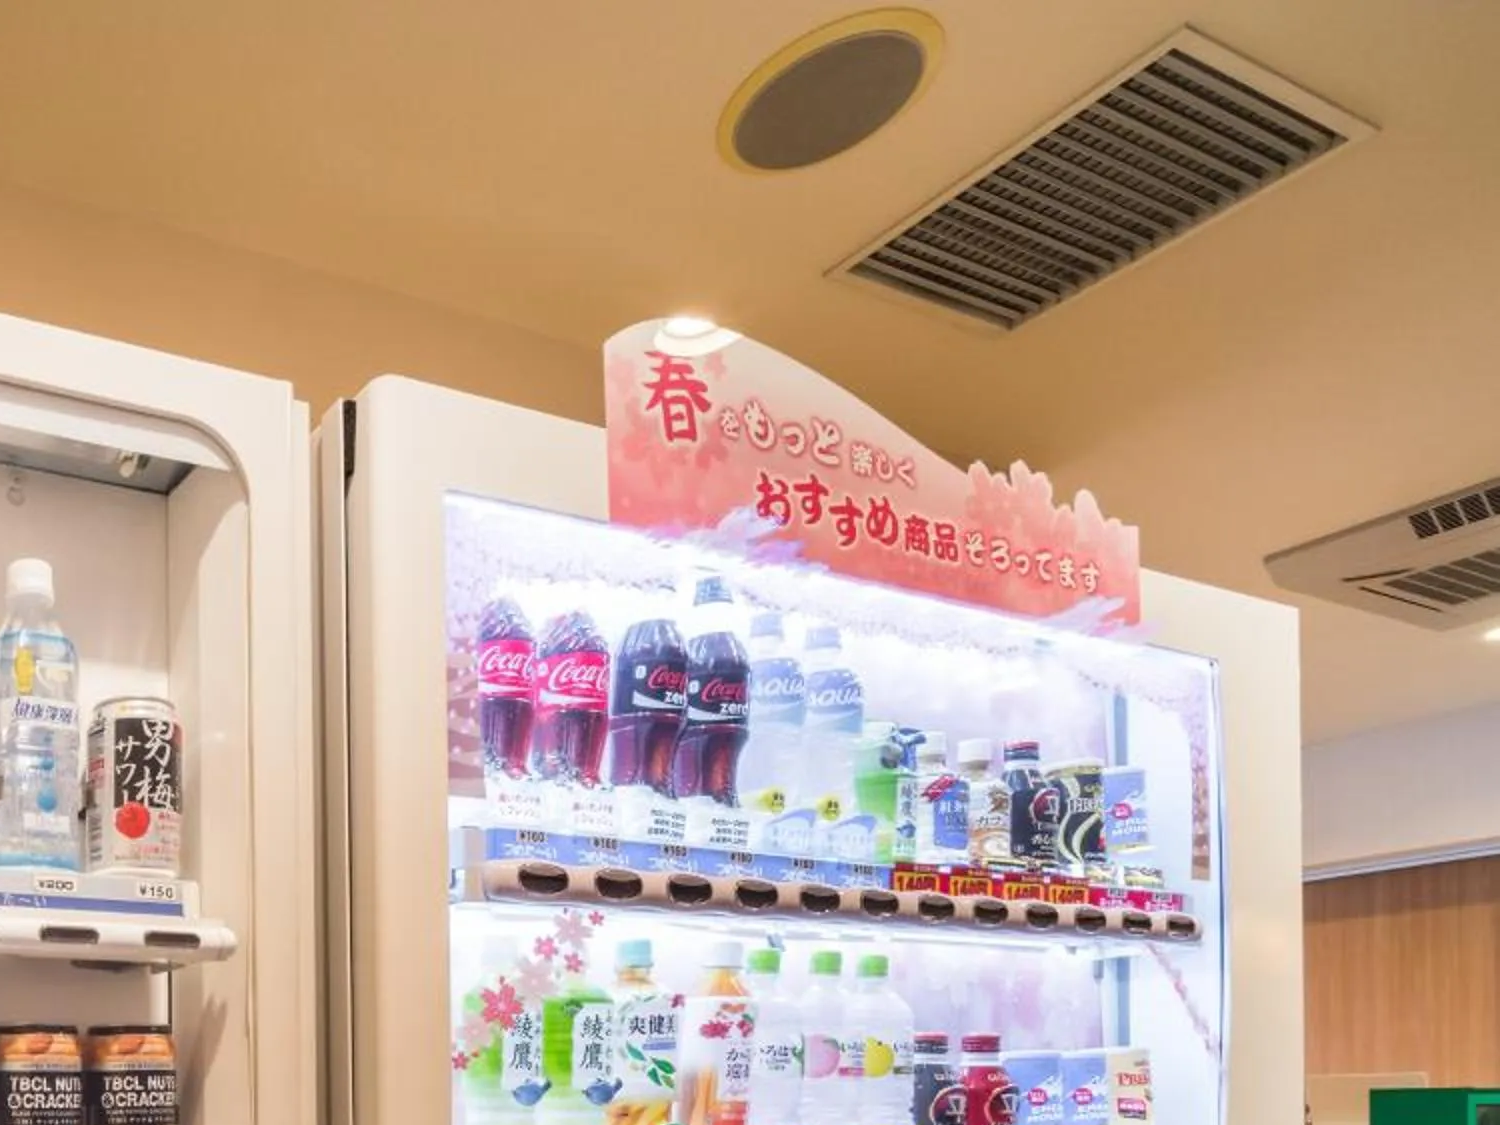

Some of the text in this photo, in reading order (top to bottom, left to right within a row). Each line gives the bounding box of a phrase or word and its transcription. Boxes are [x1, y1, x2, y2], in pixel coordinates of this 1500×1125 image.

[755, 472, 1100, 594] おすすめ商品そろってます
[114, 734, 141, 805] サワー
[134, 718, 176, 811] 男梅
[140, 885, 174, 899] ¥150
[8, 1075, 53, 1093] TBCL
[103, 1075, 145, 1092] TBCL
